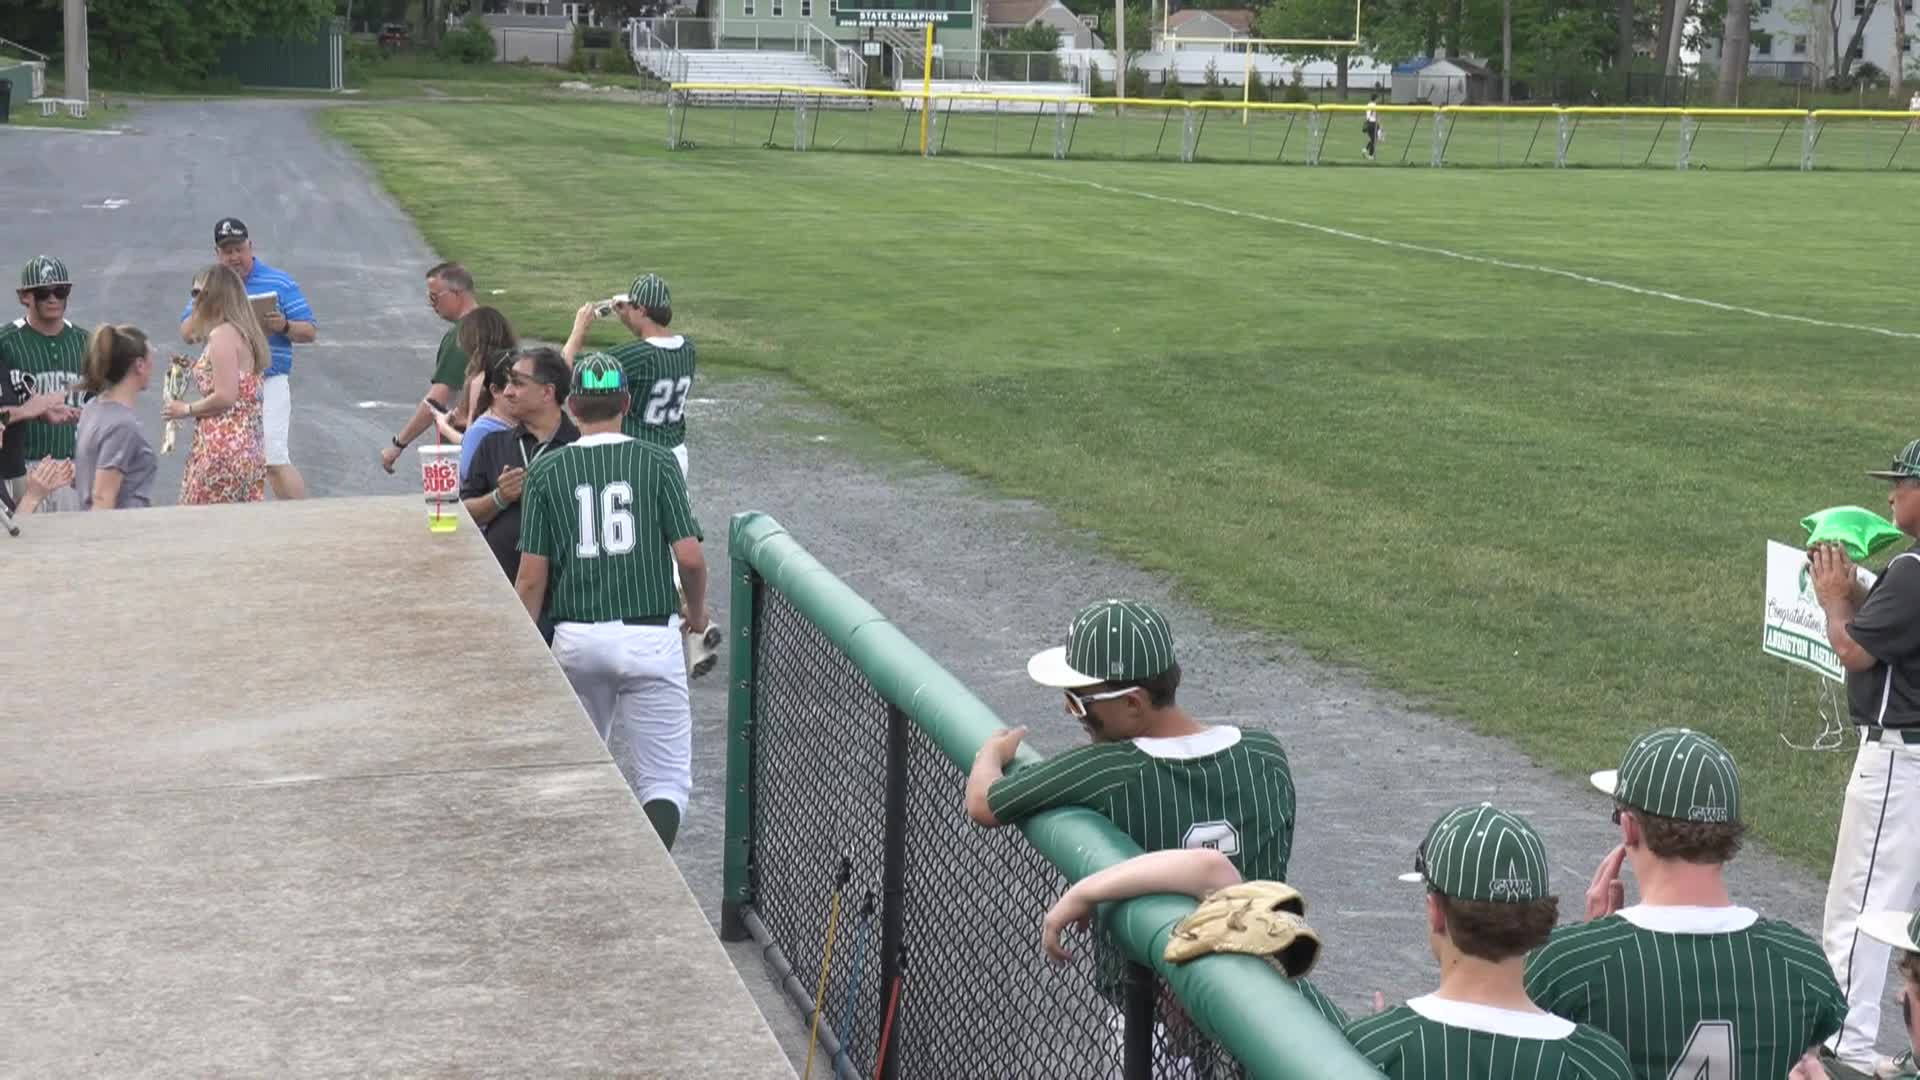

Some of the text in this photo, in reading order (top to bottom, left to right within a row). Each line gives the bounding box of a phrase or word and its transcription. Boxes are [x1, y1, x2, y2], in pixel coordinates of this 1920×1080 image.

[860, 12, 949, 21] STATE CHAMPIONS
[644, 376, 691, 424] 23
[575, 481, 636, 558] 16
[1766, 628, 1809, 660] ABINGTON
